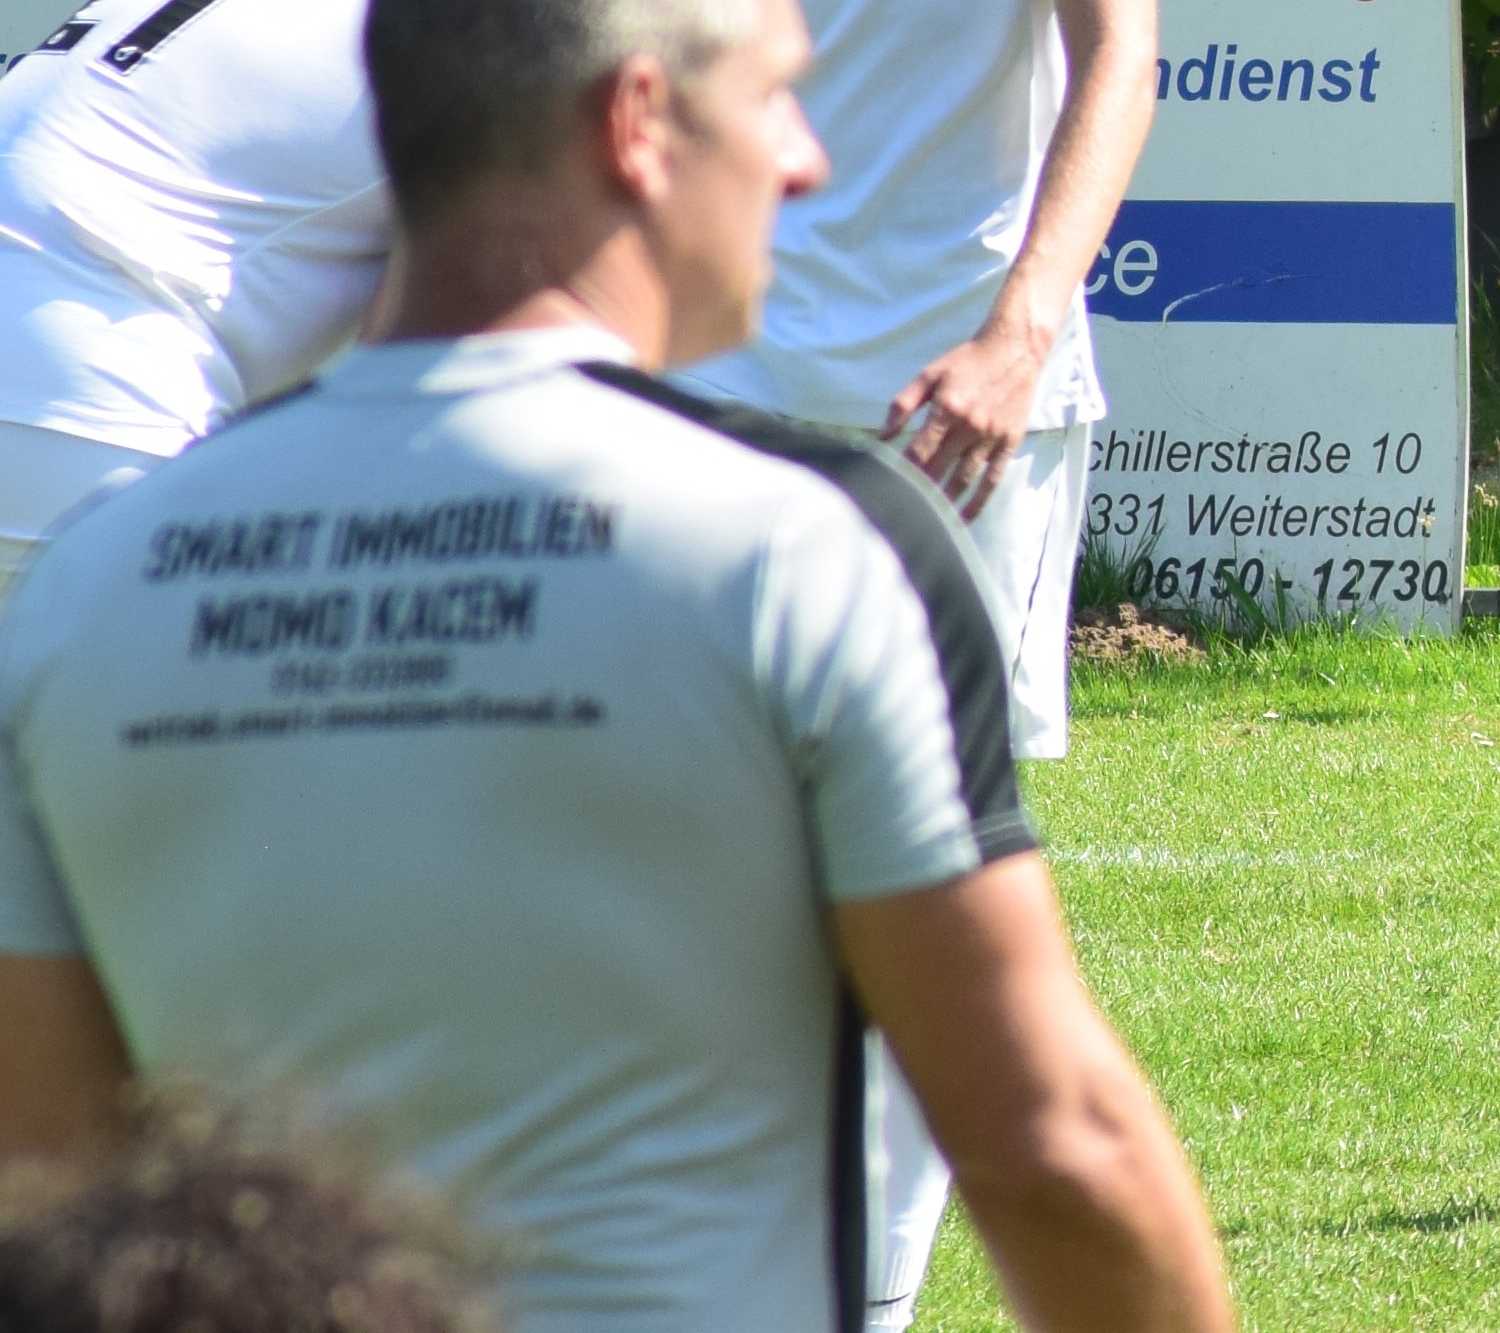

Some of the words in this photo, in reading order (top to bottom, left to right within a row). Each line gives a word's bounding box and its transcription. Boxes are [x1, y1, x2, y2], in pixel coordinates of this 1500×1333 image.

[1372, 432, 1422, 475] 10
[1188, 493, 1435, 539] Weiterstadt
[144, 511, 320, 583] SMART
